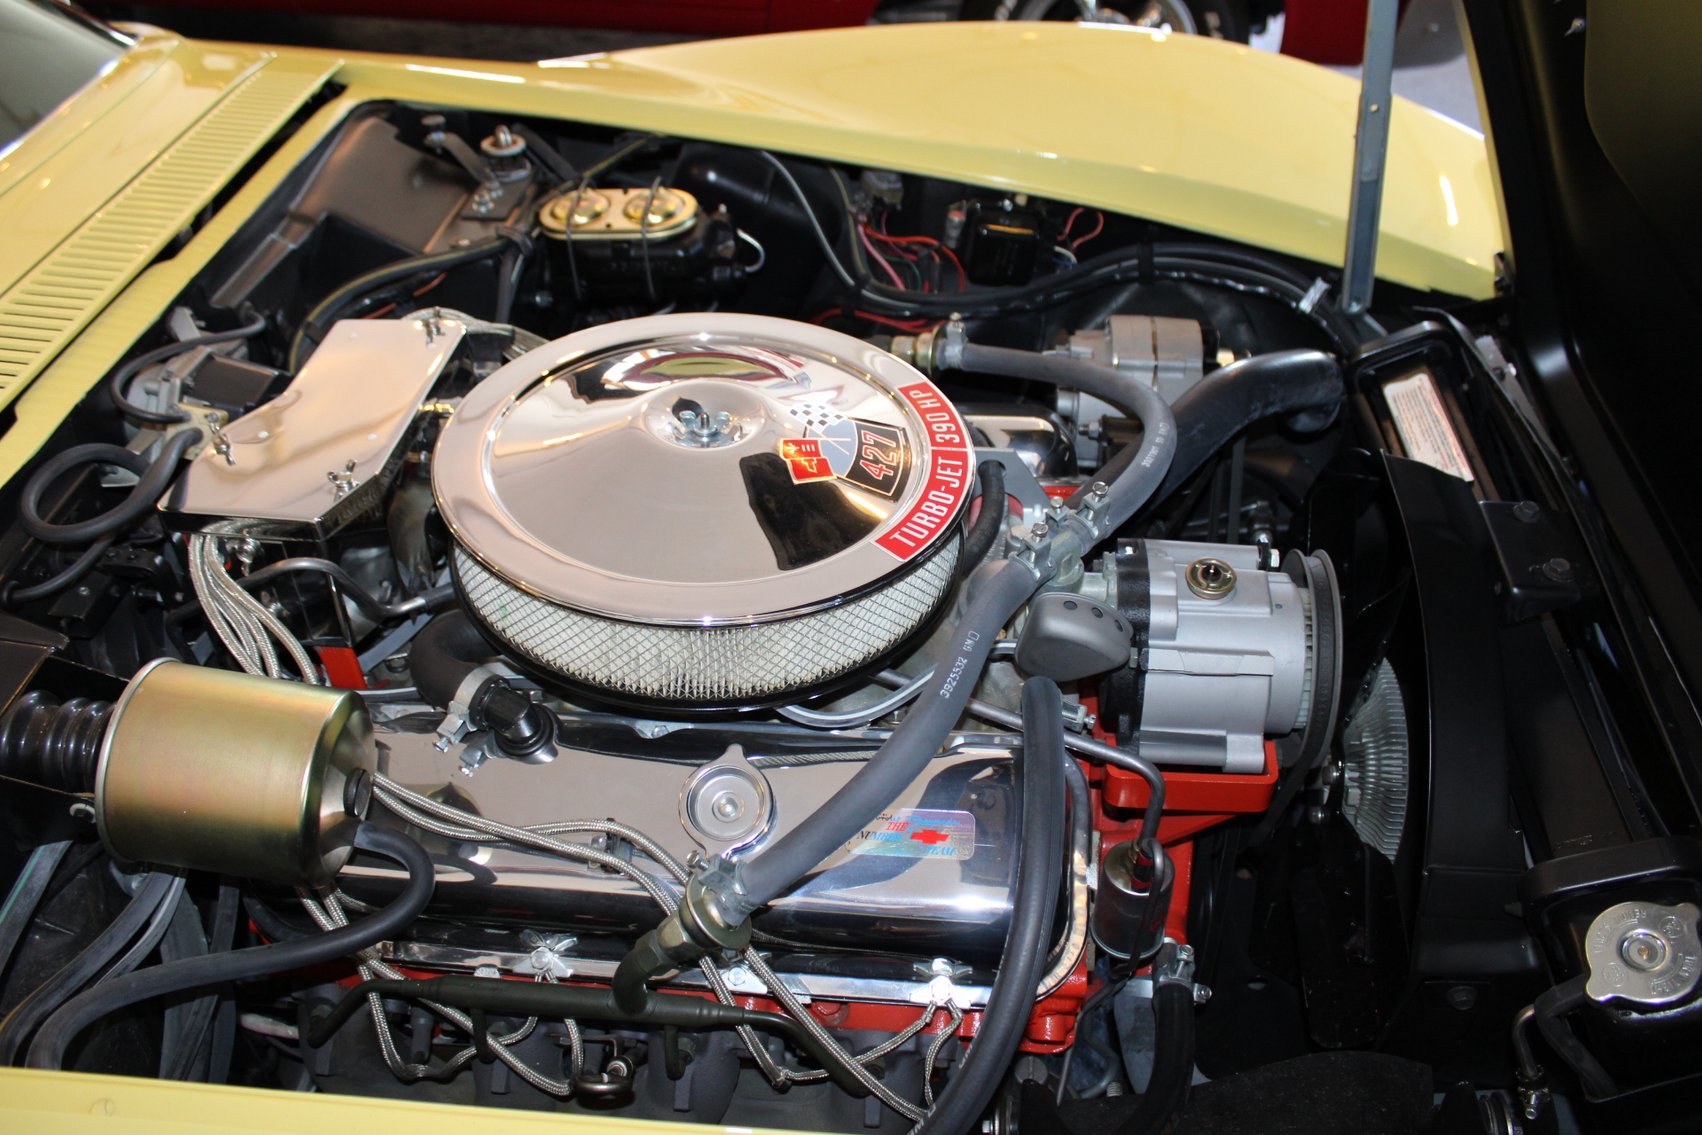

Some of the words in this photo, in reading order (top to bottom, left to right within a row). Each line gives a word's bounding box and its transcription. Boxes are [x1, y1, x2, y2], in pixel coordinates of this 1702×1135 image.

[909, 390, 941, 409] HP
[928, 412, 960, 443] 390
[860, 431, 897, 480] 427
[889, 456, 963, 547] TURBO-JET
[940, 656, 968, 698] 3925532
[885, 821, 910, 831] THE
